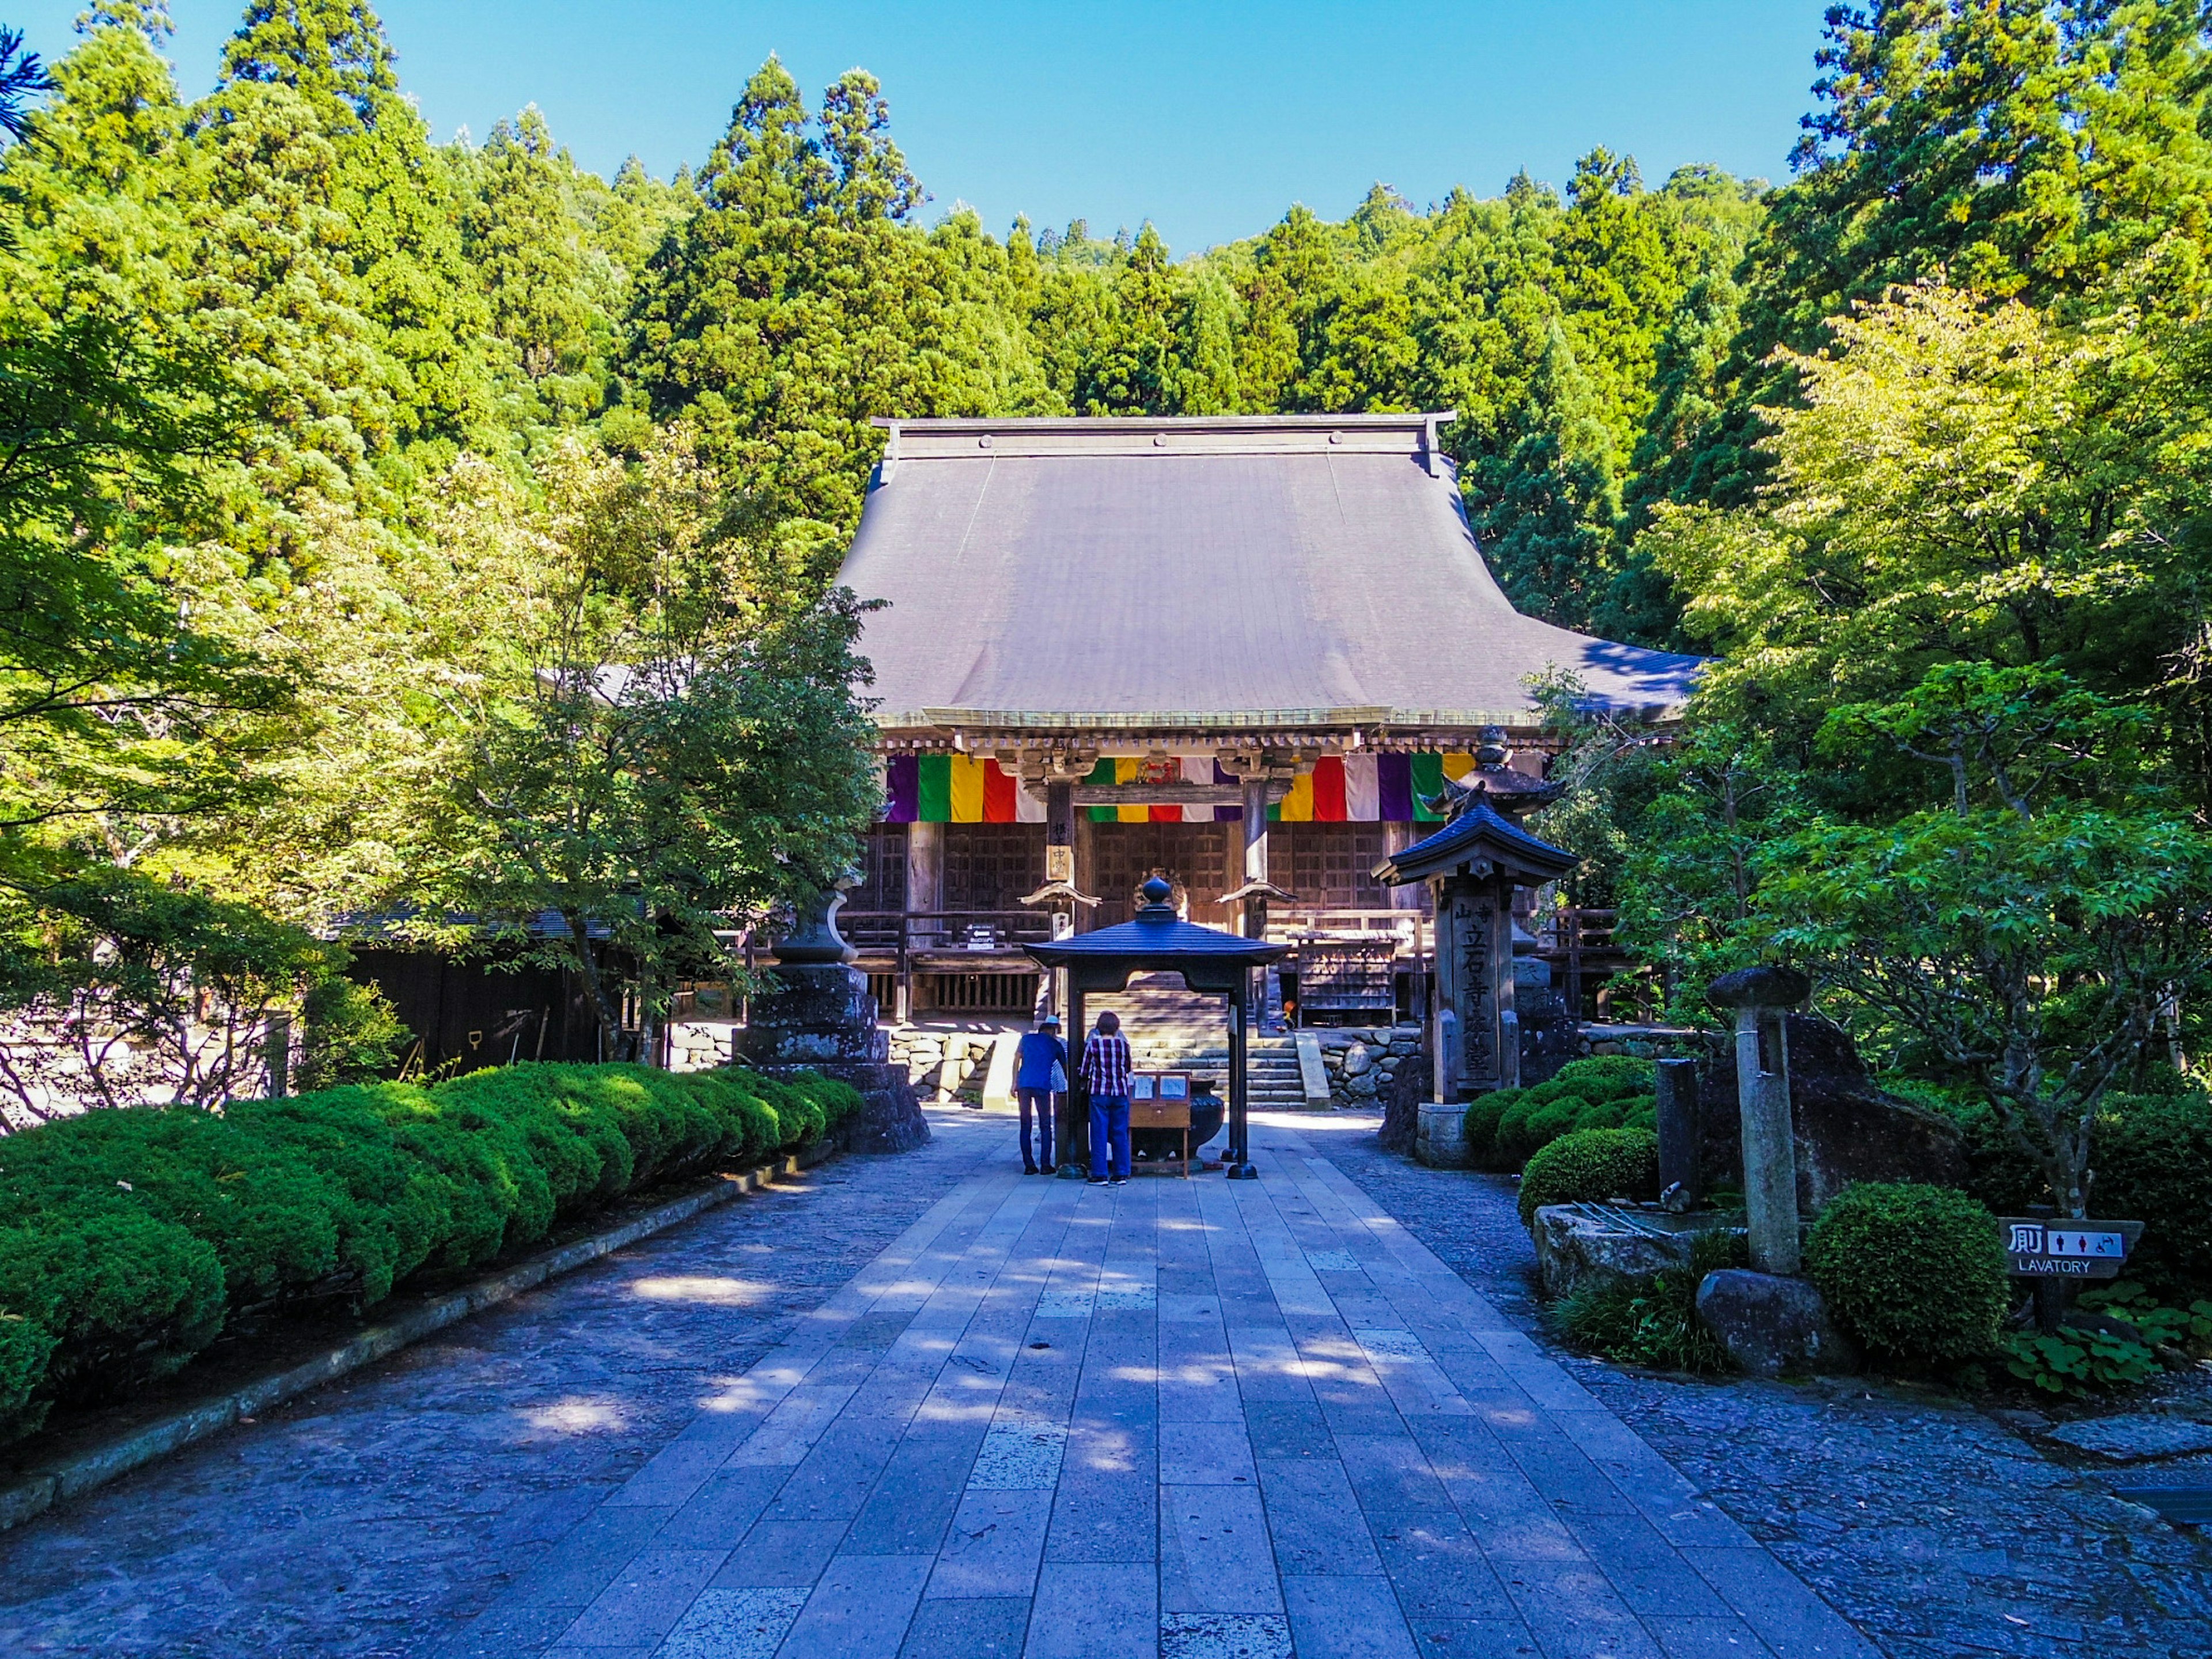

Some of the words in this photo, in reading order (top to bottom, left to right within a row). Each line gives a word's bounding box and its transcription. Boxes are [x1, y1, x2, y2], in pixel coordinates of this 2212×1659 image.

[1456, 903, 1492, 923] 山寺
[1462, 925, 1490, 1071] 立石寺本堂
[2019, 1259, 2090, 1273] LAVATORY
